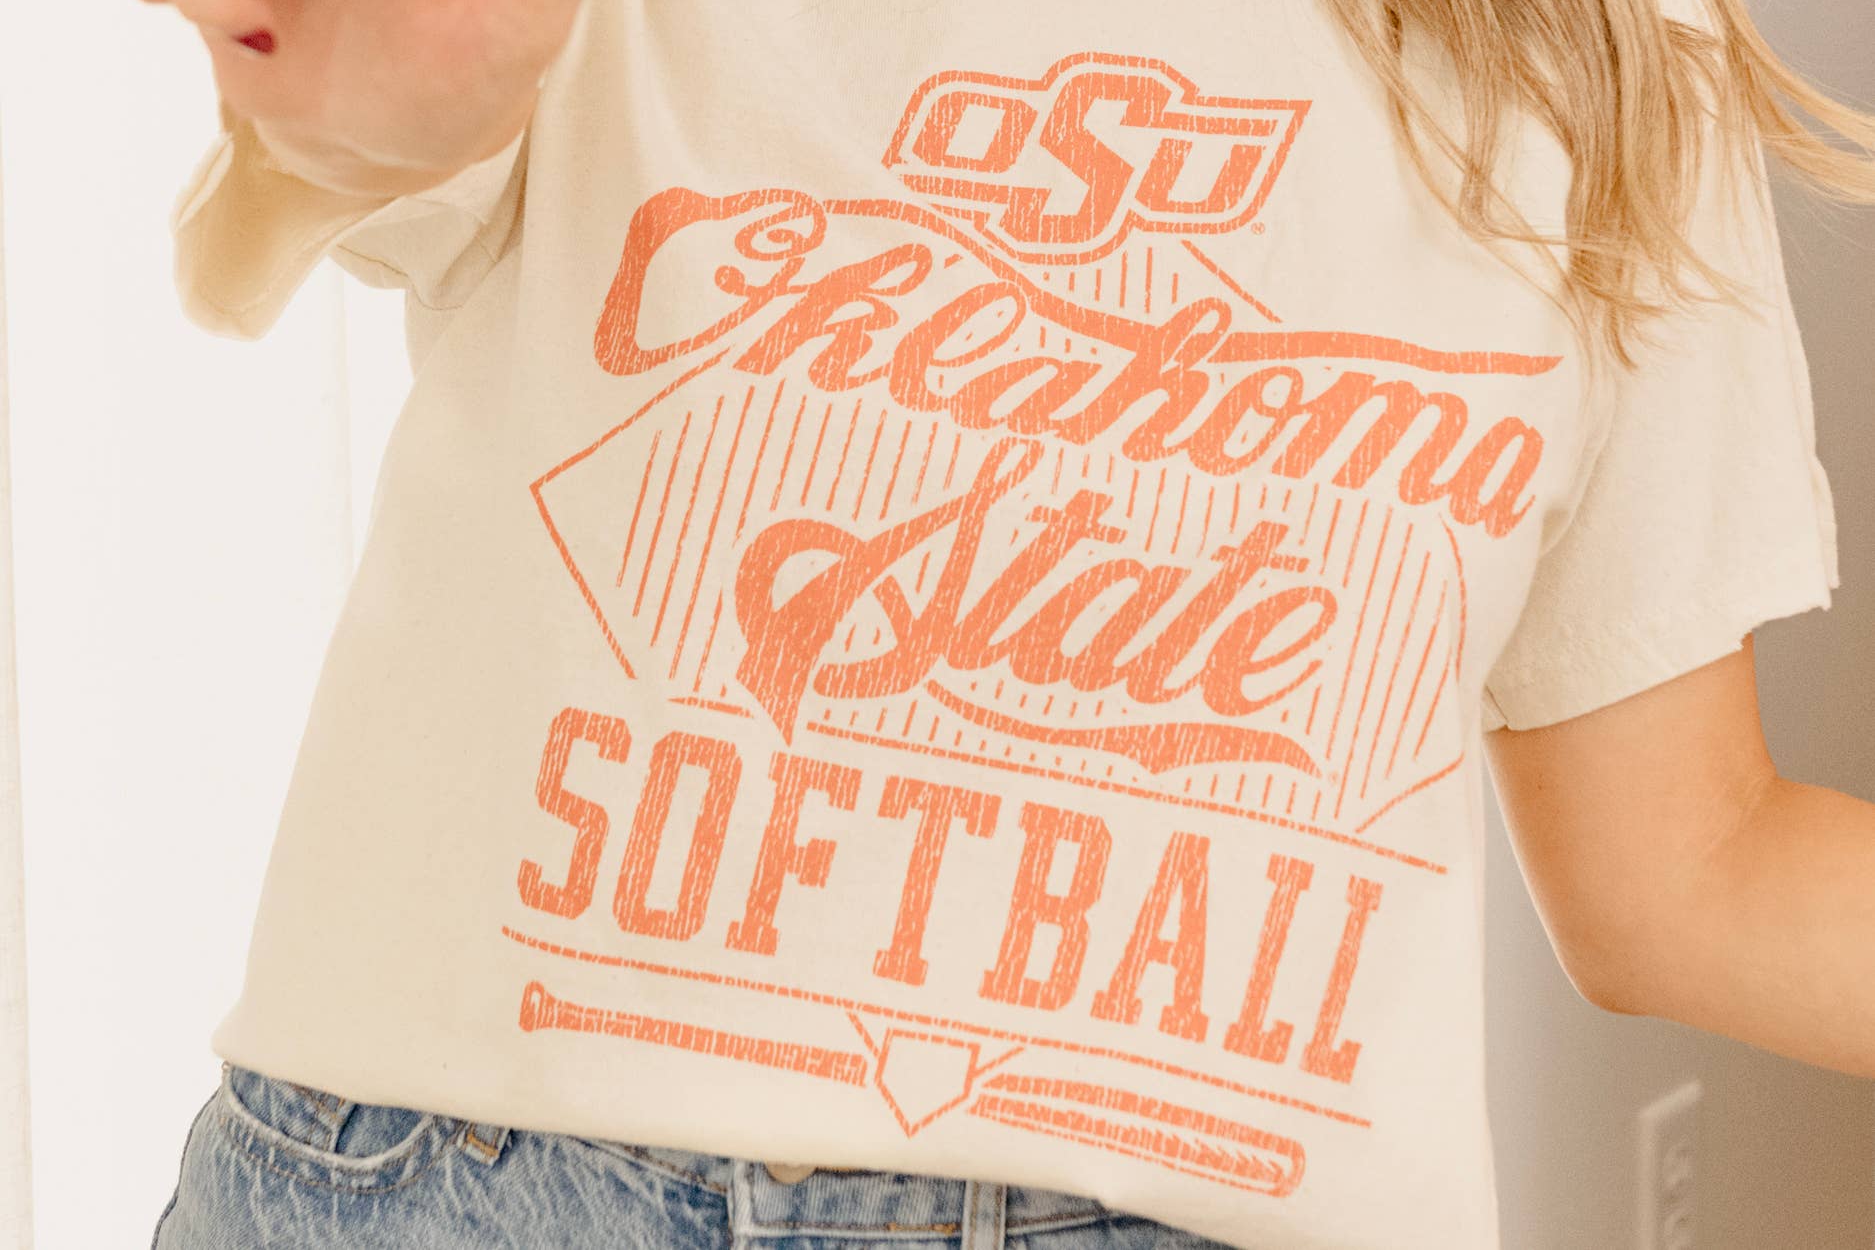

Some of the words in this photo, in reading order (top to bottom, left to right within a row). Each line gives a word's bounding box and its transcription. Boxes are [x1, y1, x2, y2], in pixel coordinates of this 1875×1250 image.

[892, 58, 1298, 257] OSU
[594, 187, 1558, 538] Oklahoma
[734, 435, 1340, 746] State
[518, 706, 1382, 1084] SOFTBALL
